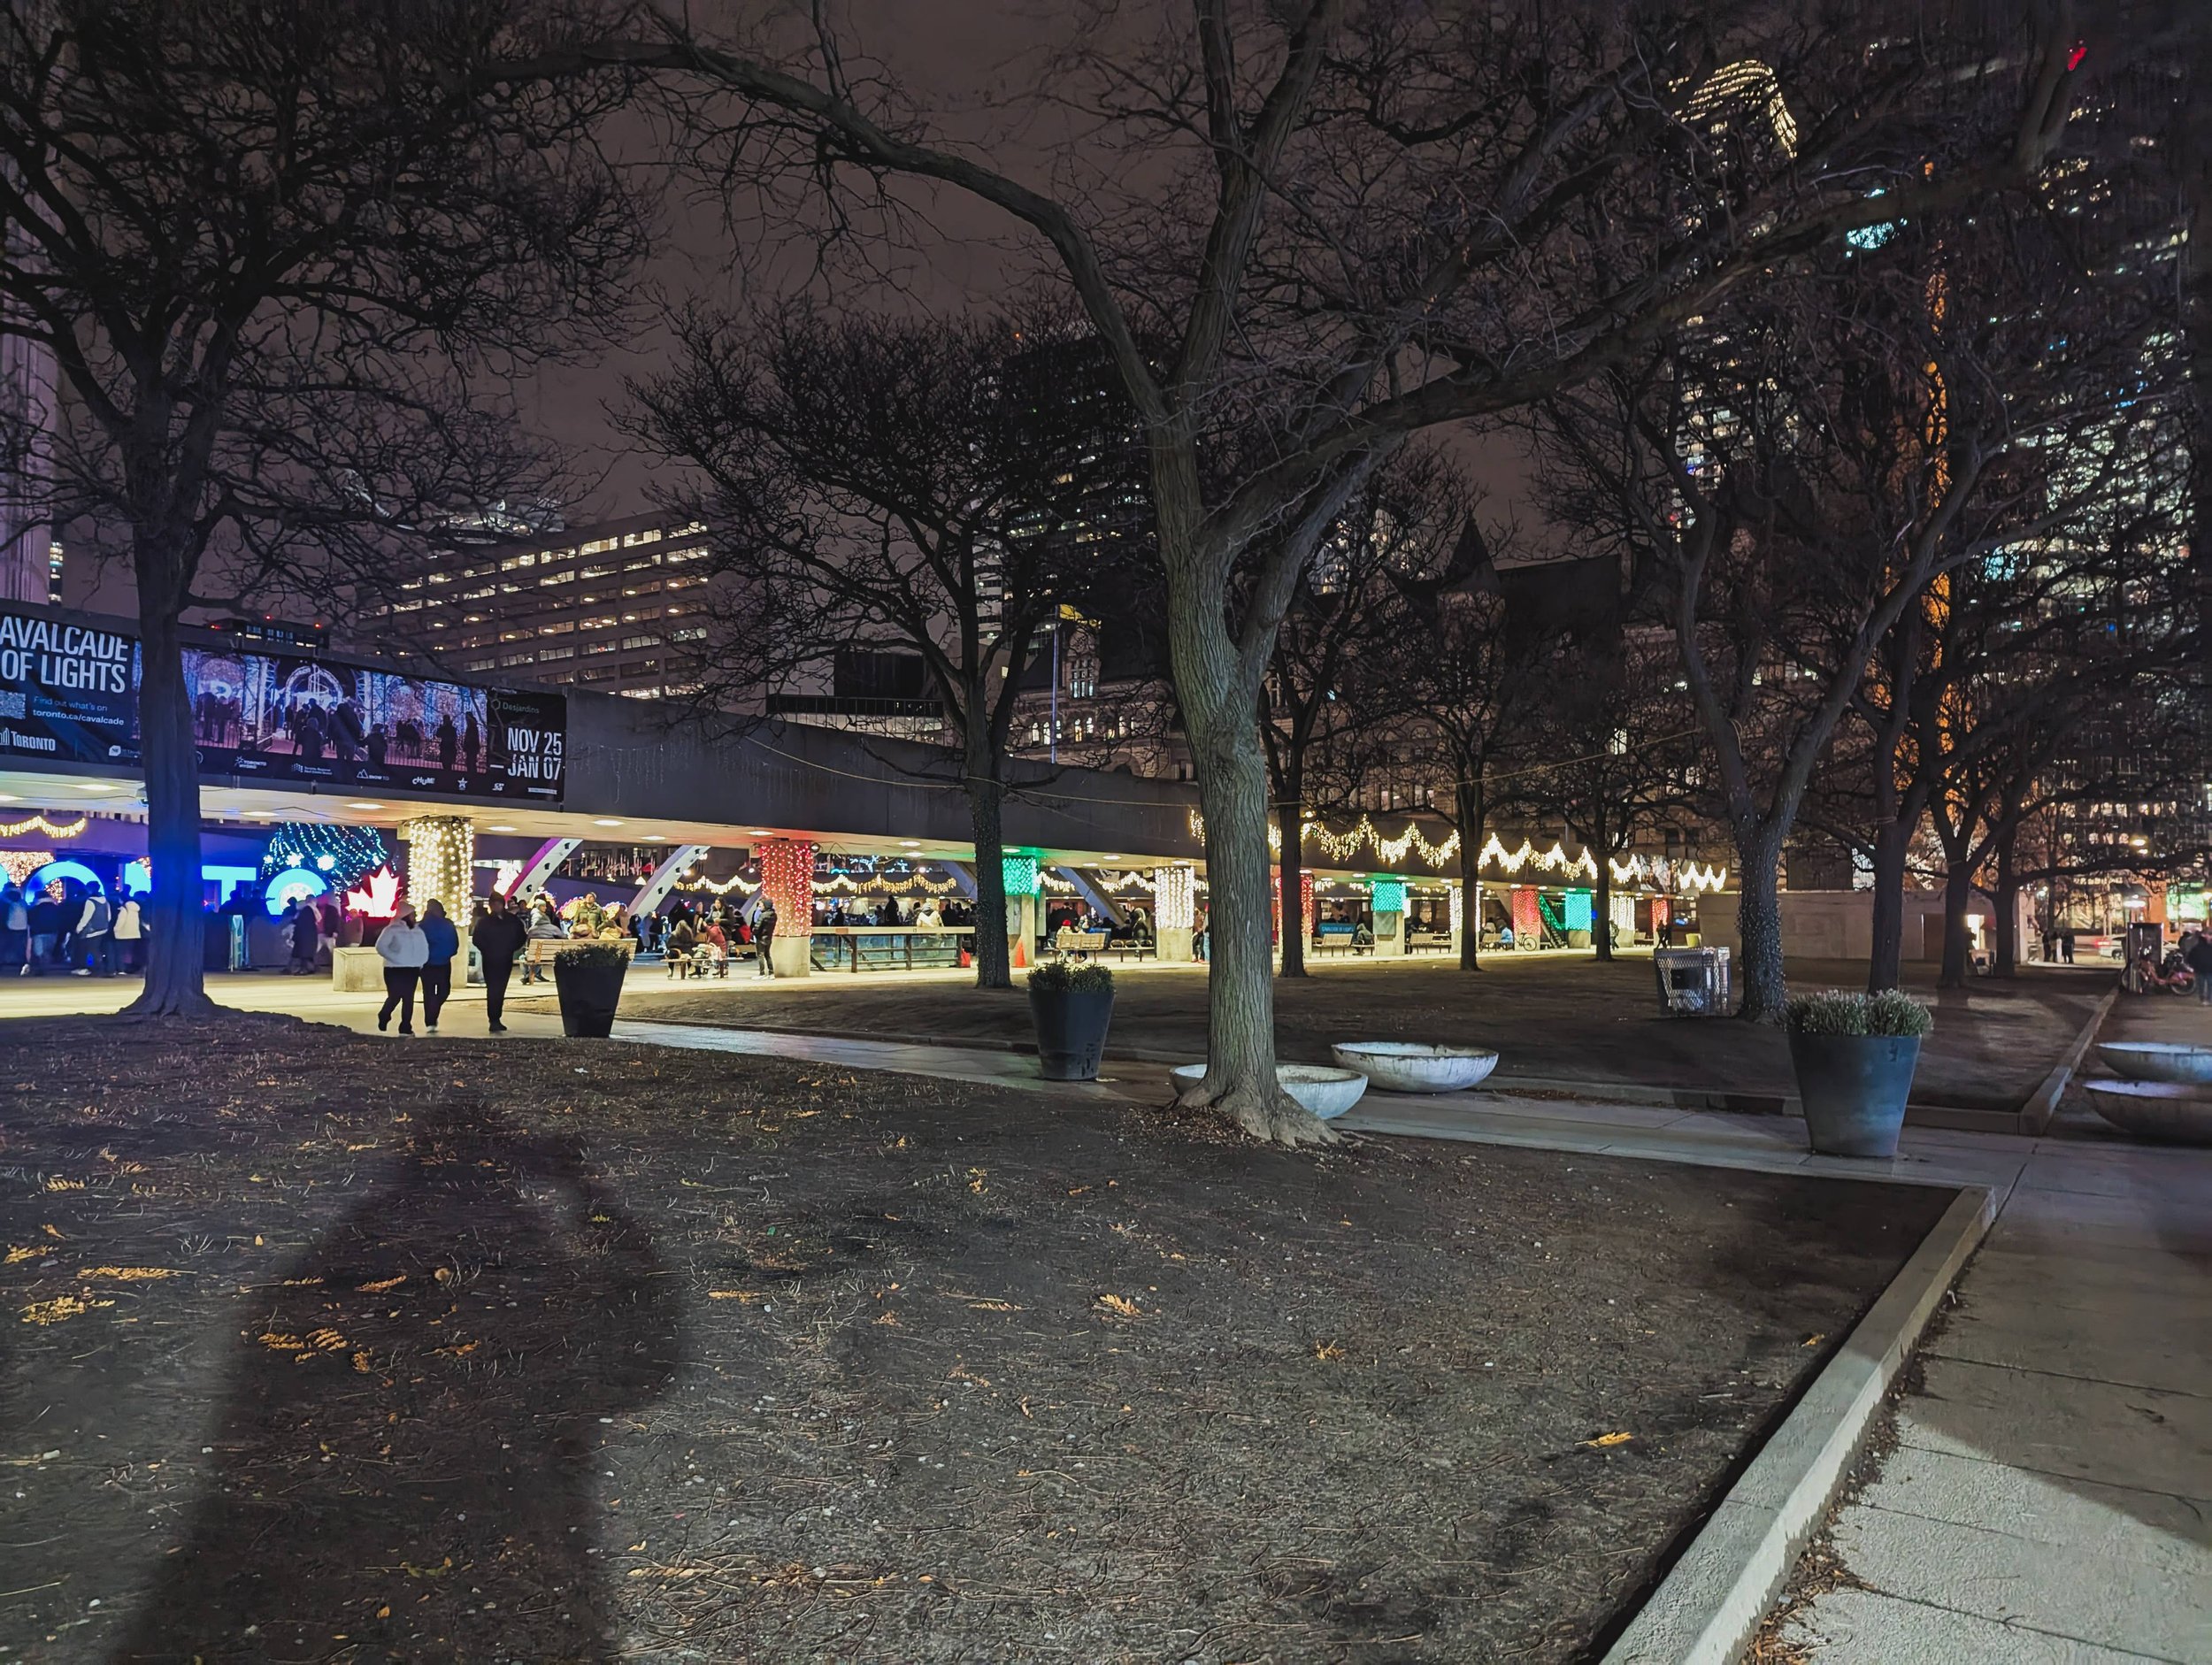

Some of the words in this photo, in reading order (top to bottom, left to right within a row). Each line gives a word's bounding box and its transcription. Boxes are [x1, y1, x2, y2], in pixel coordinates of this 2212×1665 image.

[1, 649, 34, 681] OF
[41, 655, 126, 694] LIGHTS
[34, 696, 52, 706] Find
[68, 702, 96, 710] what's
[503, 702, 540, 714] Desjardins
[33, 709, 125, 725] toronto.ca/cavalcade
[507, 727, 540, 753] NOV
[543, 732, 562, 756] 25
[507, 754, 540, 779] JAN
[543, 756, 562, 780] 07
